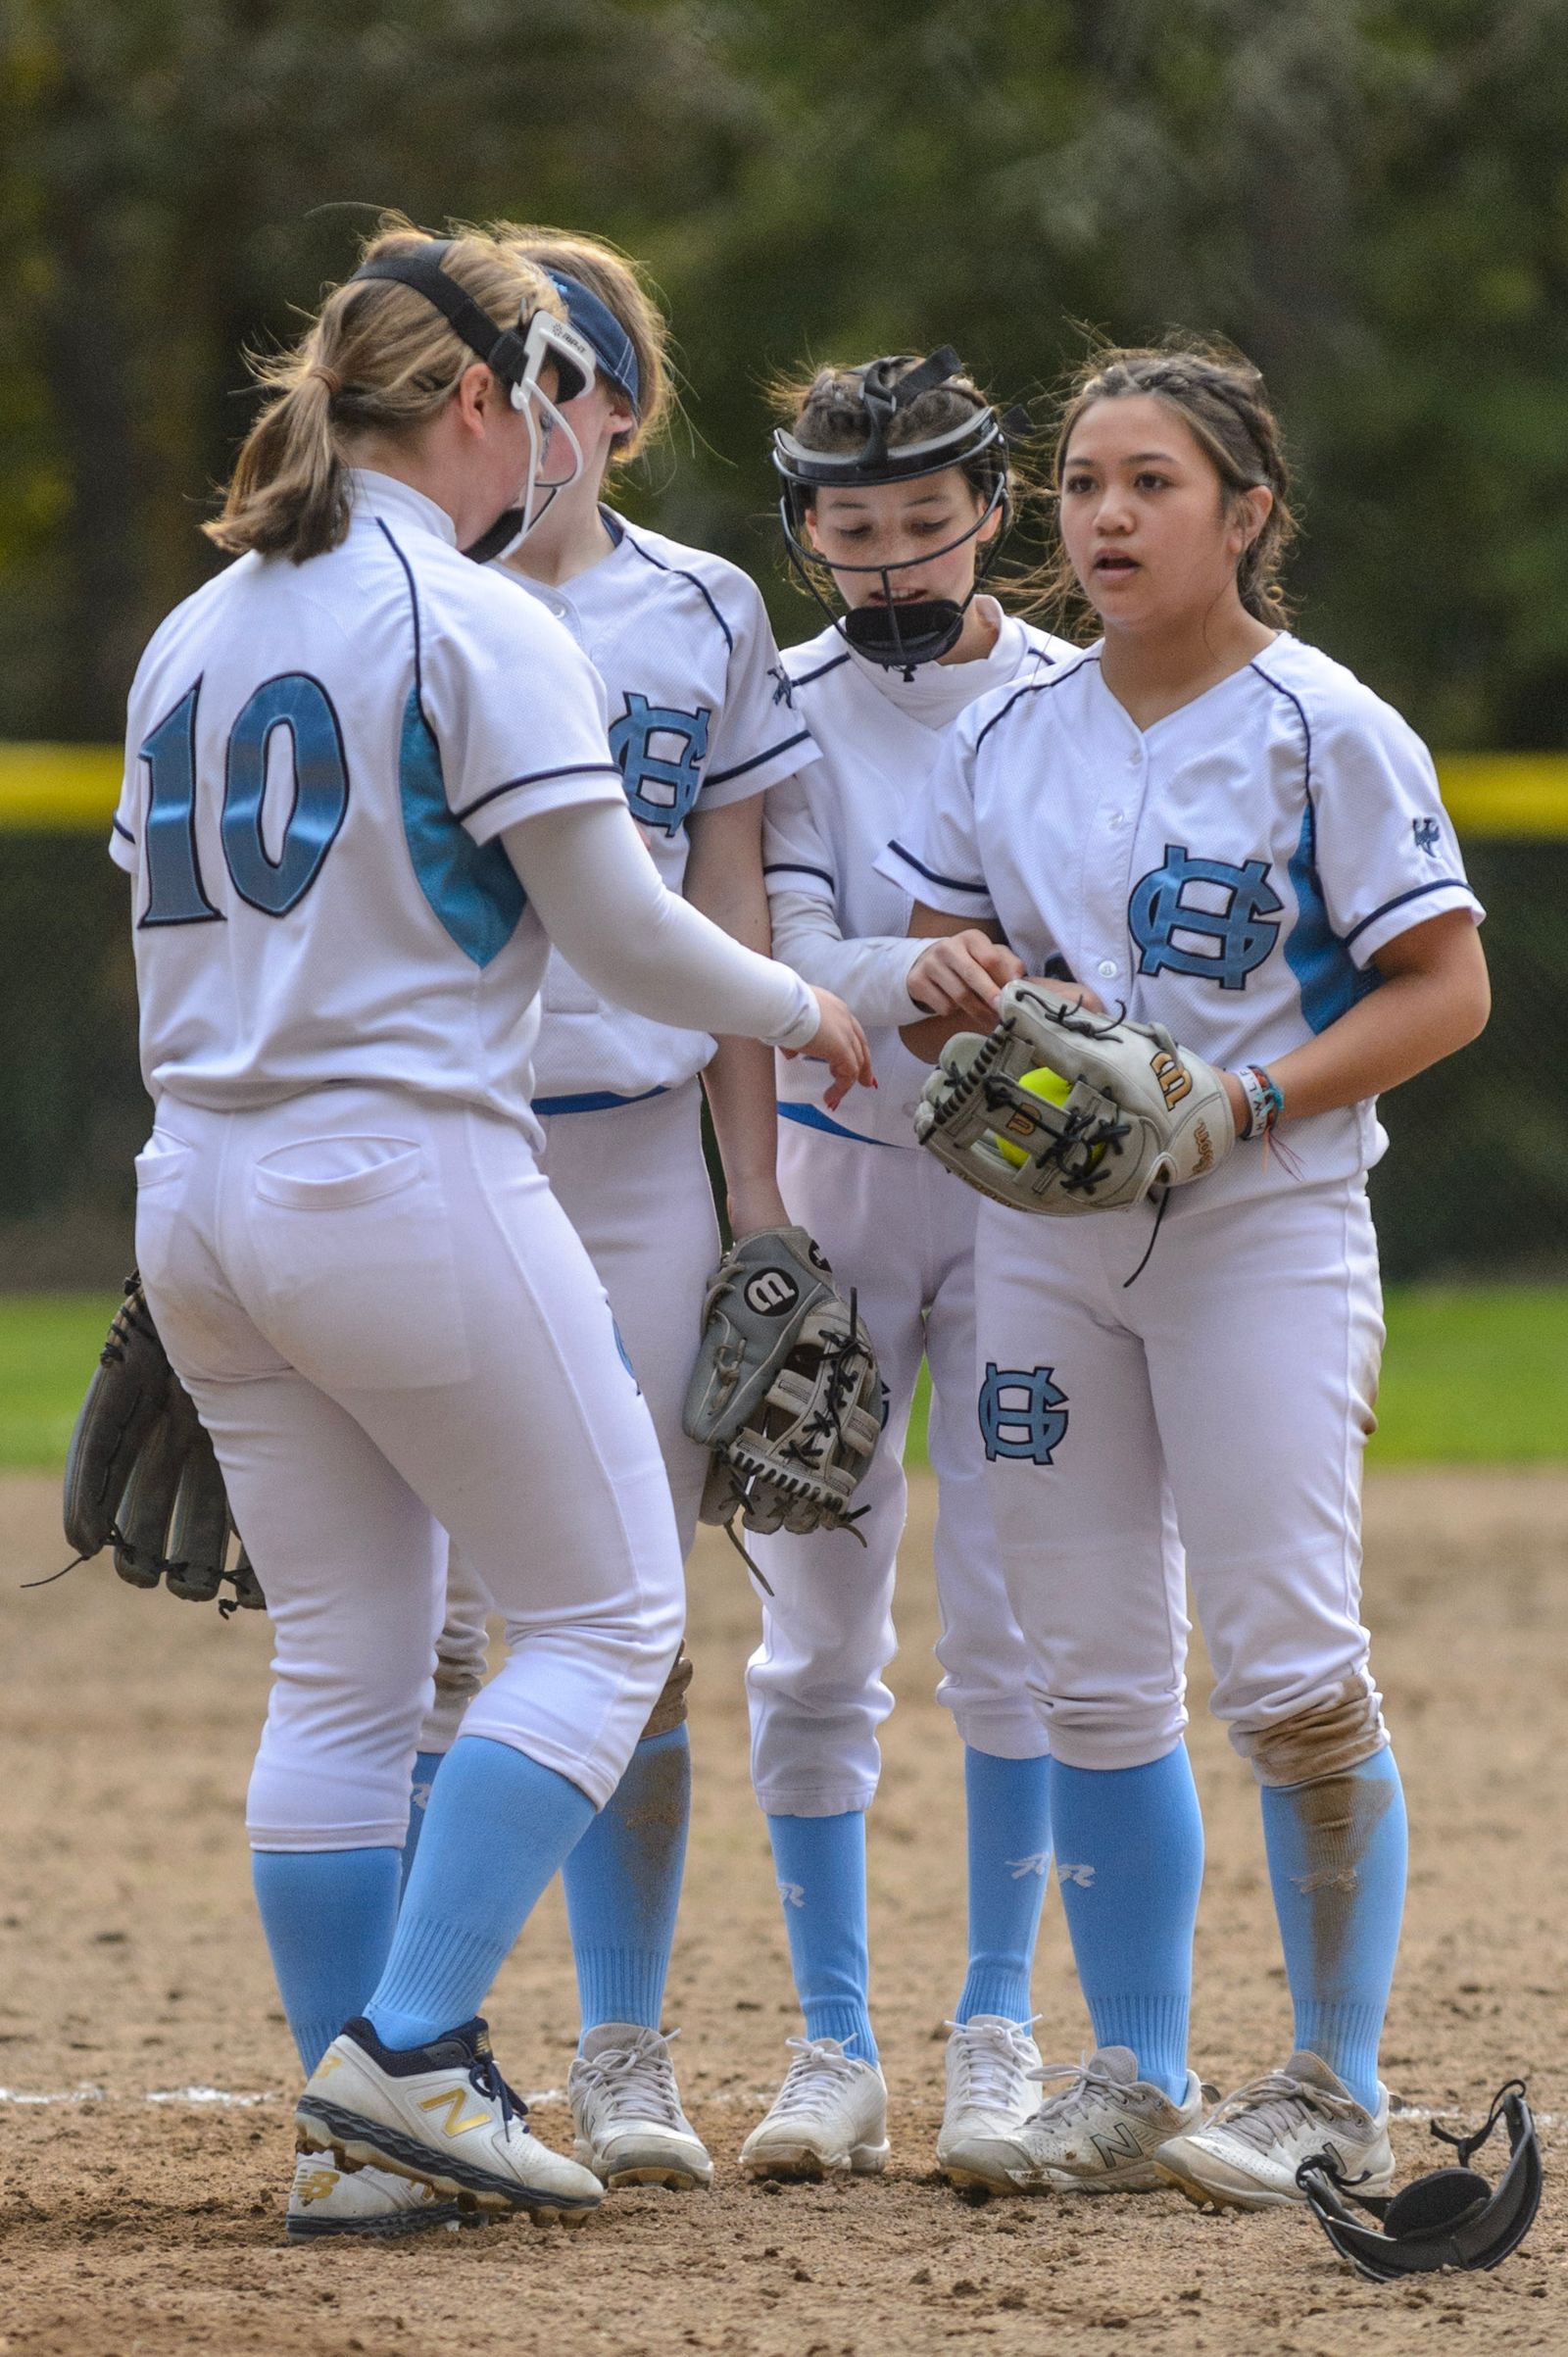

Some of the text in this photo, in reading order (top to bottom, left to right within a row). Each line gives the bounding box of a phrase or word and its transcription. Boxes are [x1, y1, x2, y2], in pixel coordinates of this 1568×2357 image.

[136, 669, 350, 930] 10
[417, 2087, 491, 2137] N
[1090, 2123, 1144, 2168] N
